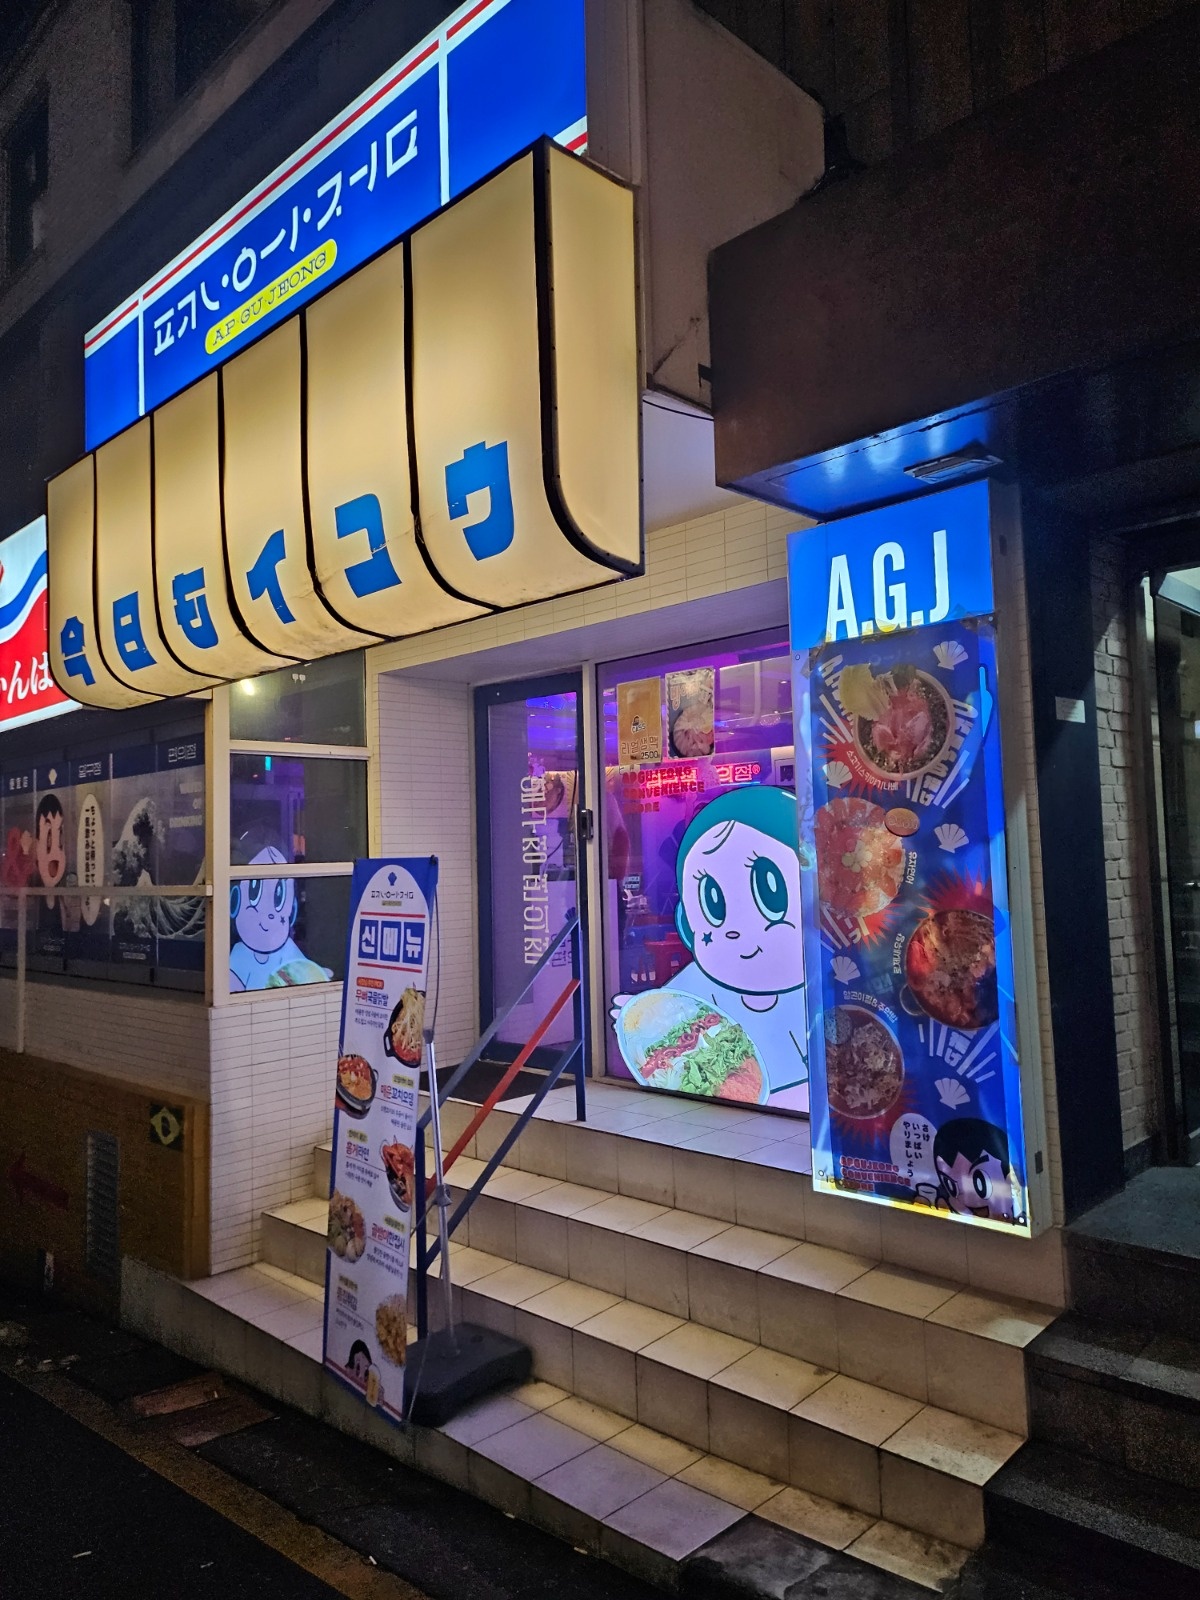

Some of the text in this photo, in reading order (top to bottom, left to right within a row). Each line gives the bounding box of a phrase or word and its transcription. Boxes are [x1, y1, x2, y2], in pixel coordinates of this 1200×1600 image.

[168, 743, 197, 763] 편의점
[640, 750, 659, 760] 2500
[905, 851, 918, 885] 유자연어
[361, 925, 422, 959] 신메뉴
[922, 1124, 931, 1142] さけ
[346, 1141, 370, 1162] 홍게라면
[903, 1121, 914, 1178] やりましょう
